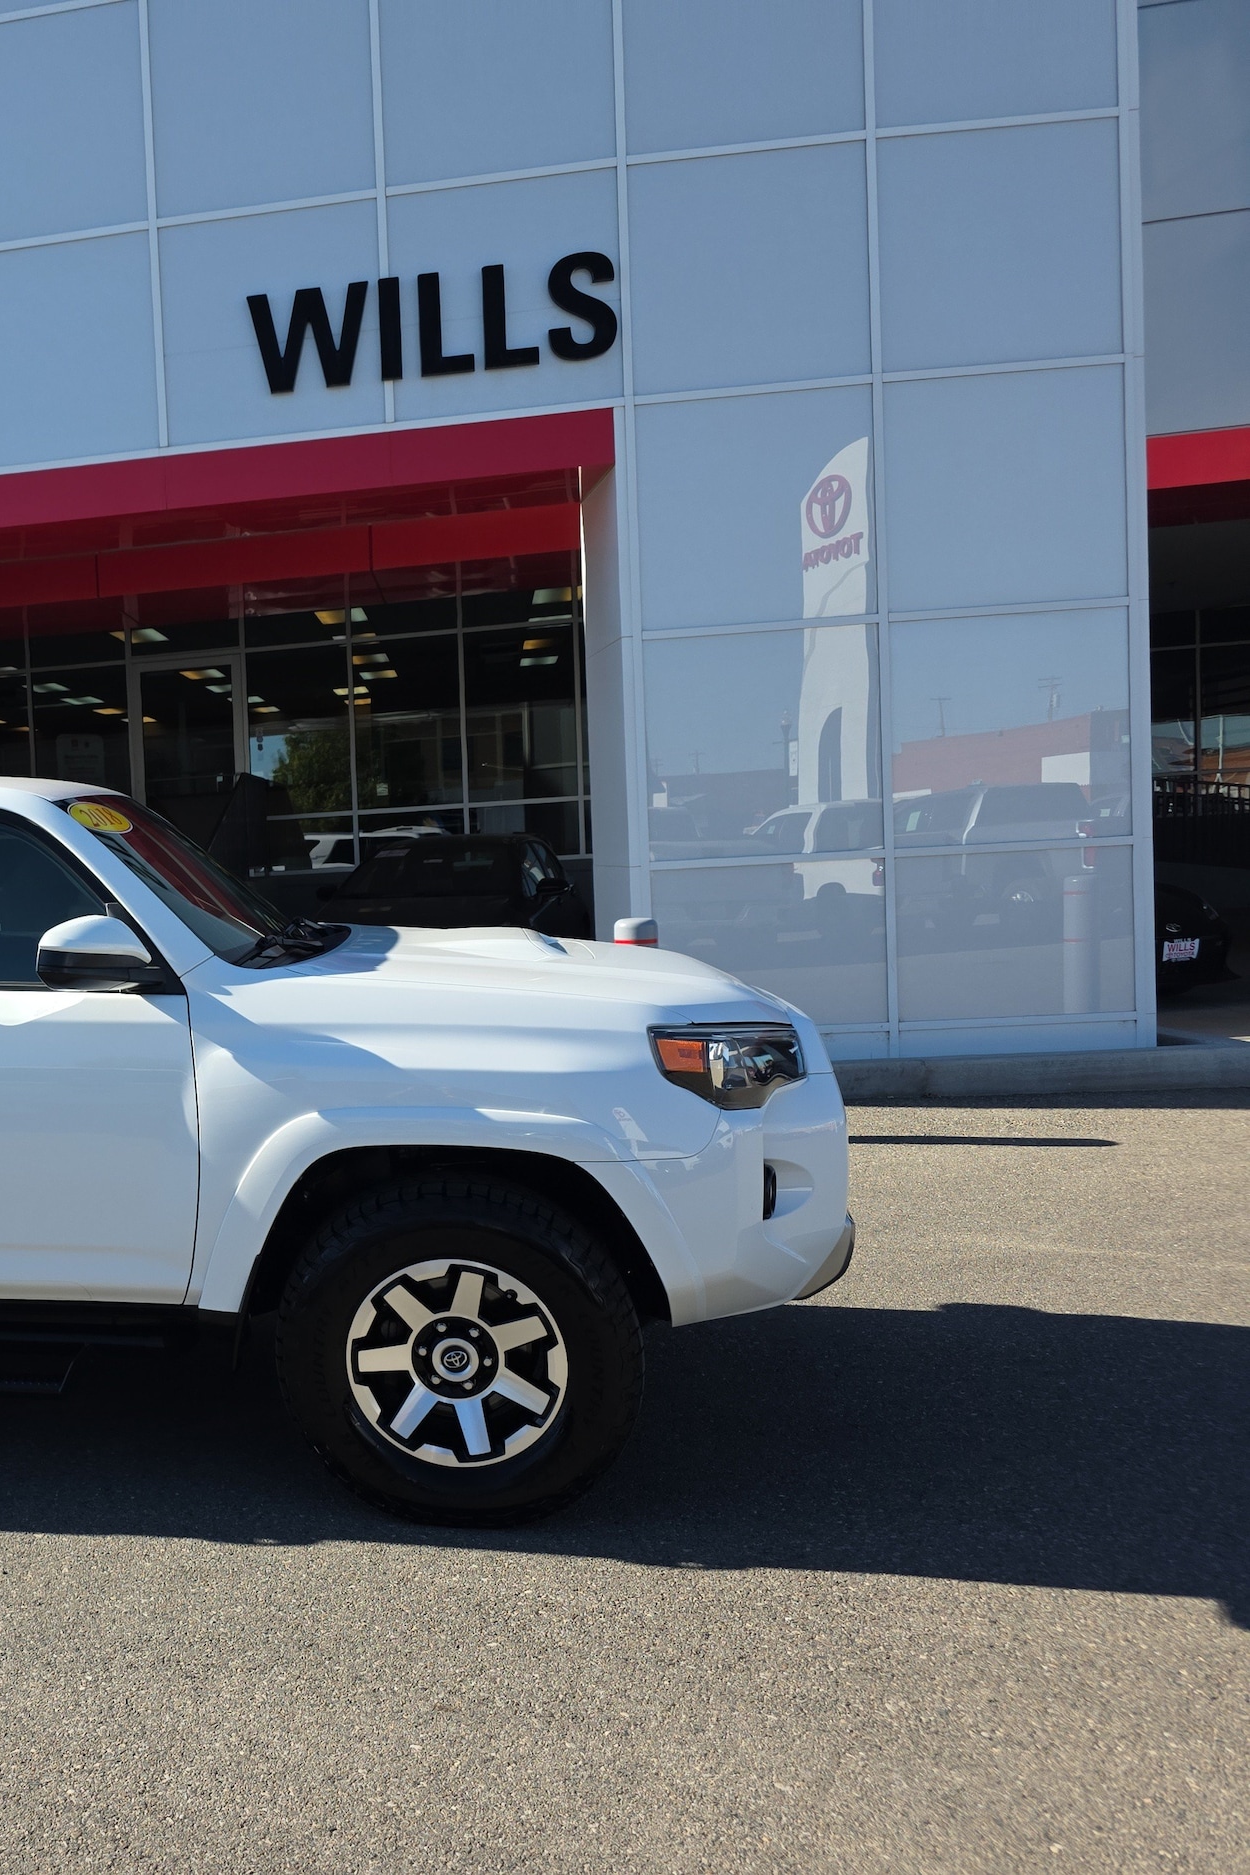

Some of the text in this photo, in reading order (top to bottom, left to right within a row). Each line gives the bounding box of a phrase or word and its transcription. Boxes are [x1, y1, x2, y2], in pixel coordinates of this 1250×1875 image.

[246, 251, 618, 394] WILLS
[79, 807, 123, 828] 2018
[1167, 942, 1196, 953] WILLS
